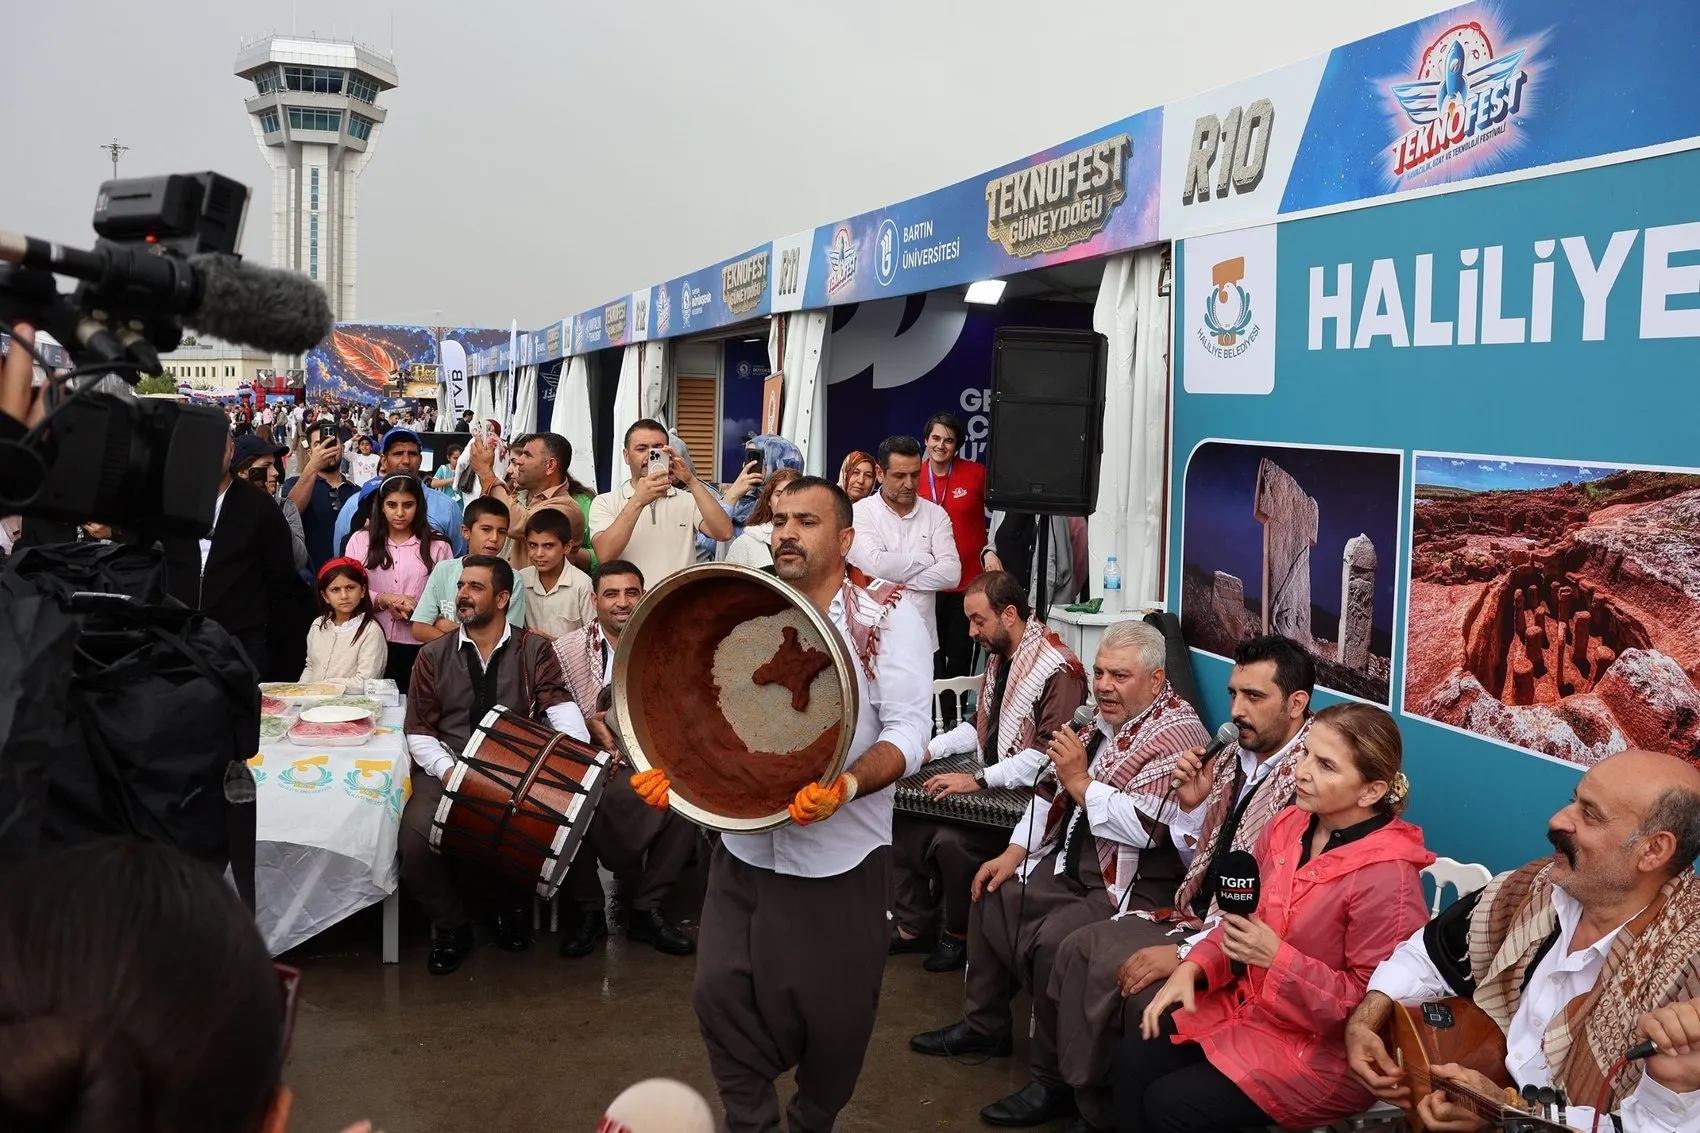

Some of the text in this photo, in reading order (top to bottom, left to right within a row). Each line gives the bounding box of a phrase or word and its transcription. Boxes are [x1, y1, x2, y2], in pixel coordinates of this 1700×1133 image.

[1393, 71, 1527, 176] TEKNOFEST
[1182, 98, 1275, 206] R10
[987, 134, 1131, 224] TEKNOFEST
[903, 220, 933, 243] BARTIN
[1009, 194, 1103, 244] GÜNEYDOĞU
[722, 251, 769, 292] TEKNOFEST
[778, 247, 800, 296] R11
[902, 237, 960, 269] ÜNİVERSİTESİ
[1308, 221, 1700, 351] HALİLİYE
[1197, 323, 1261, 359] HALİLİYE BELEDİYESİ
[1220, 875, 1255, 889] TGRT
[1221, 891, 1253, 901] HABER
